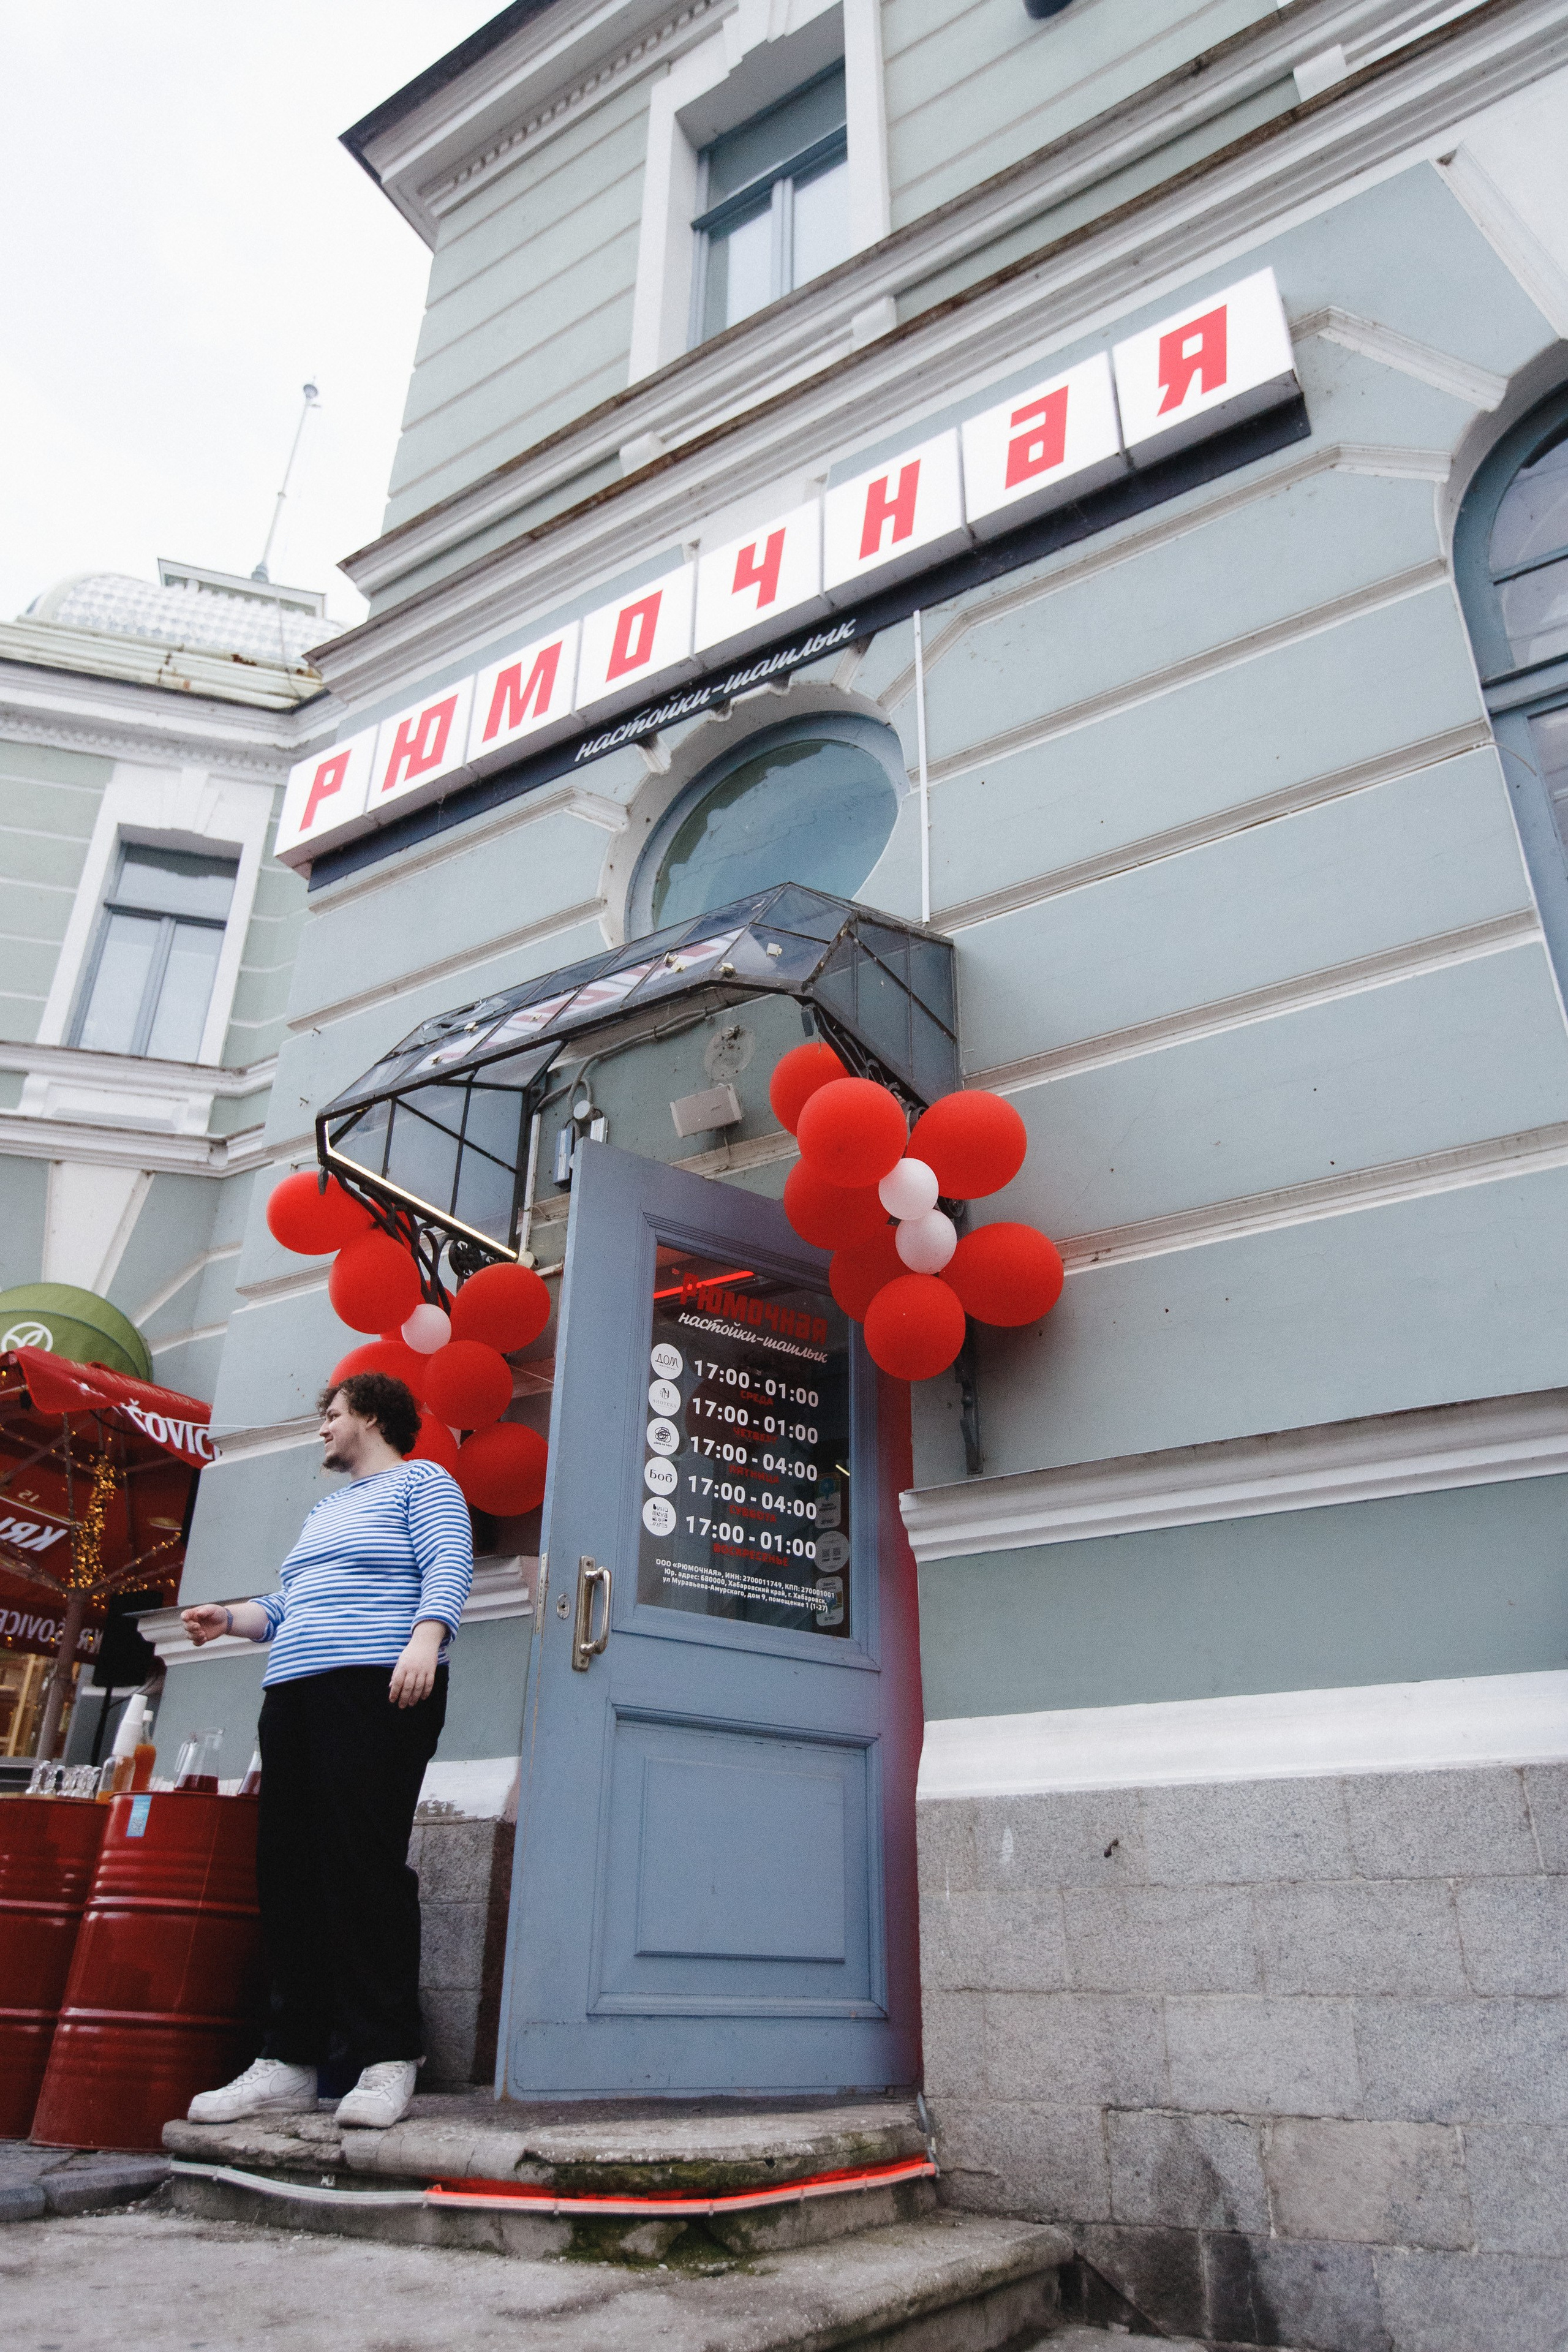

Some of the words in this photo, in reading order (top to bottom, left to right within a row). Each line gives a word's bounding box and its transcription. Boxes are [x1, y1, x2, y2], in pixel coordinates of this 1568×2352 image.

[575, 619, 856, 762] настойки-шашлык
[678, 1312, 828, 1363] настойки-шашлык
[655, 1354, 679, 1368] ДОМ
[695, 1360, 750, 1389] 17:00
[766, 1379, 819, 1408] 01:00
[740, 1390, 774, 1406] СРЕДА
[692, 1398, 748, 1426] 17:00
[764, 1416, 818, 1444] 01:00
[649, 1469, 673, 1483] Боб
[690, 1436, 747, 1464] 17:00
[763, 1454, 817, 1481] 04:00
[729, 1464, 779, 1484] ПЯТНИЦА
[688, 1476, 745, 1503] 17:00
[762, 1492, 816, 1520] 04:00
[729, 1504, 777, 1523] СУББОТА
[686, 1516, 744, 1544] 17:00
[761, 1531, 816, 1559] 01:00
[713, 1542, 789, 1567] ВОСКРЕСЕНЬЕ
[672, 1577, 746, 1597] Муравьева-Амурского,
[769, 1596, 804, 1607] помещение
[673, 1562, 723, 1578] «РЮМОЧНАЯ»,
[785, 1583, 800, 1592] КПП:
[801, 1586, 834, 1598] 270001001
[678, 1571, 699, 1580] адрес:
[701, 1575, 727, 1586] 680000,
[728, 1580, 769, 1593] Хабаровский
[771, 1588, 786, 1597] край,
[793, 1593, 827, 1605] Хабаровск,
